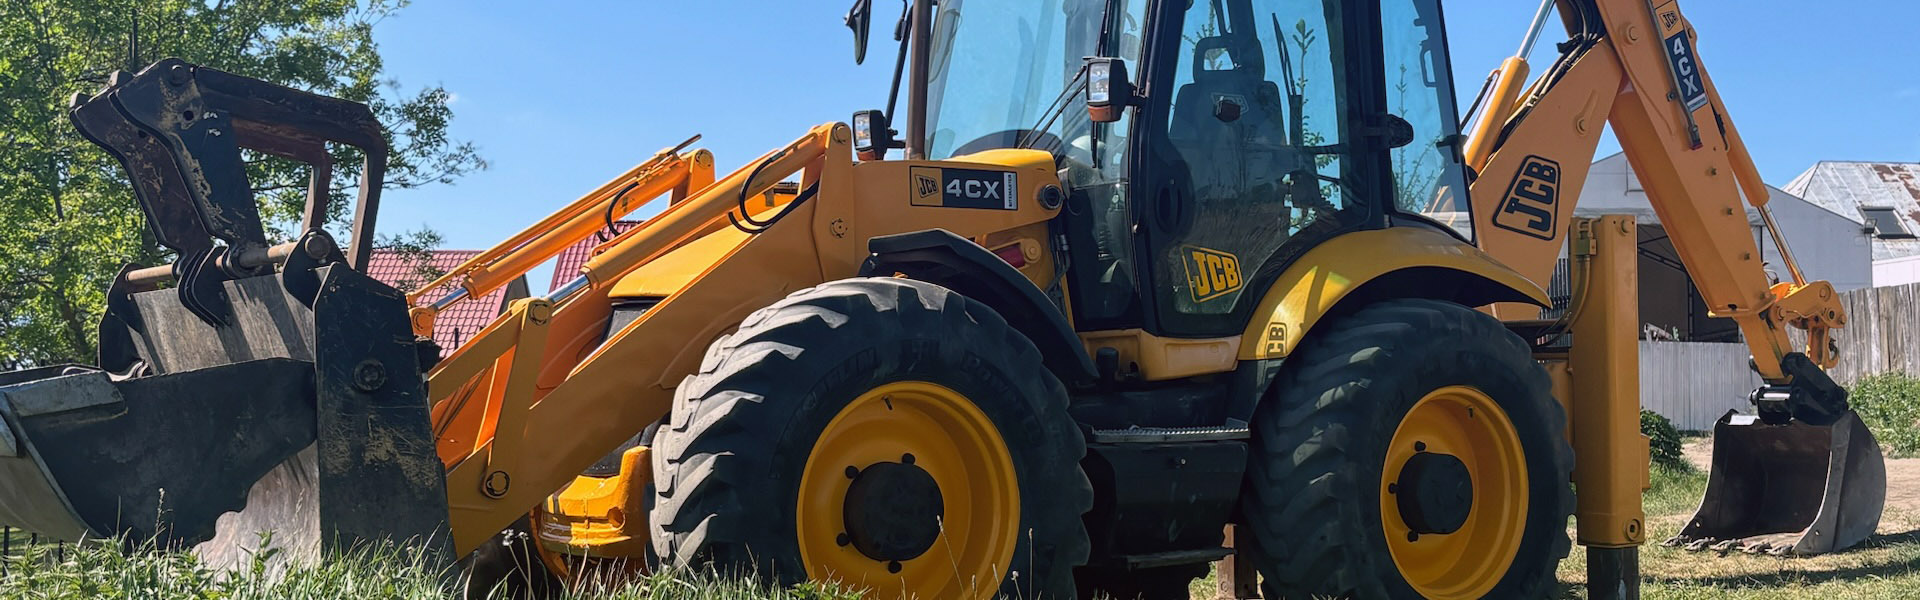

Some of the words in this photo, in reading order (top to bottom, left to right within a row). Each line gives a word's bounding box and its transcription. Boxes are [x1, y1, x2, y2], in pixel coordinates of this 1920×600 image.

[1662, 12, 1678, 29] JCB
[1673, 37, 1698, 97] 4CX
[919, 177, 938, 196] JCB
[946, 179, 1000, 199] 4CX
[1504, 161, 1557, 232] JCB
[1192, 251, 1239, 297] JCB
